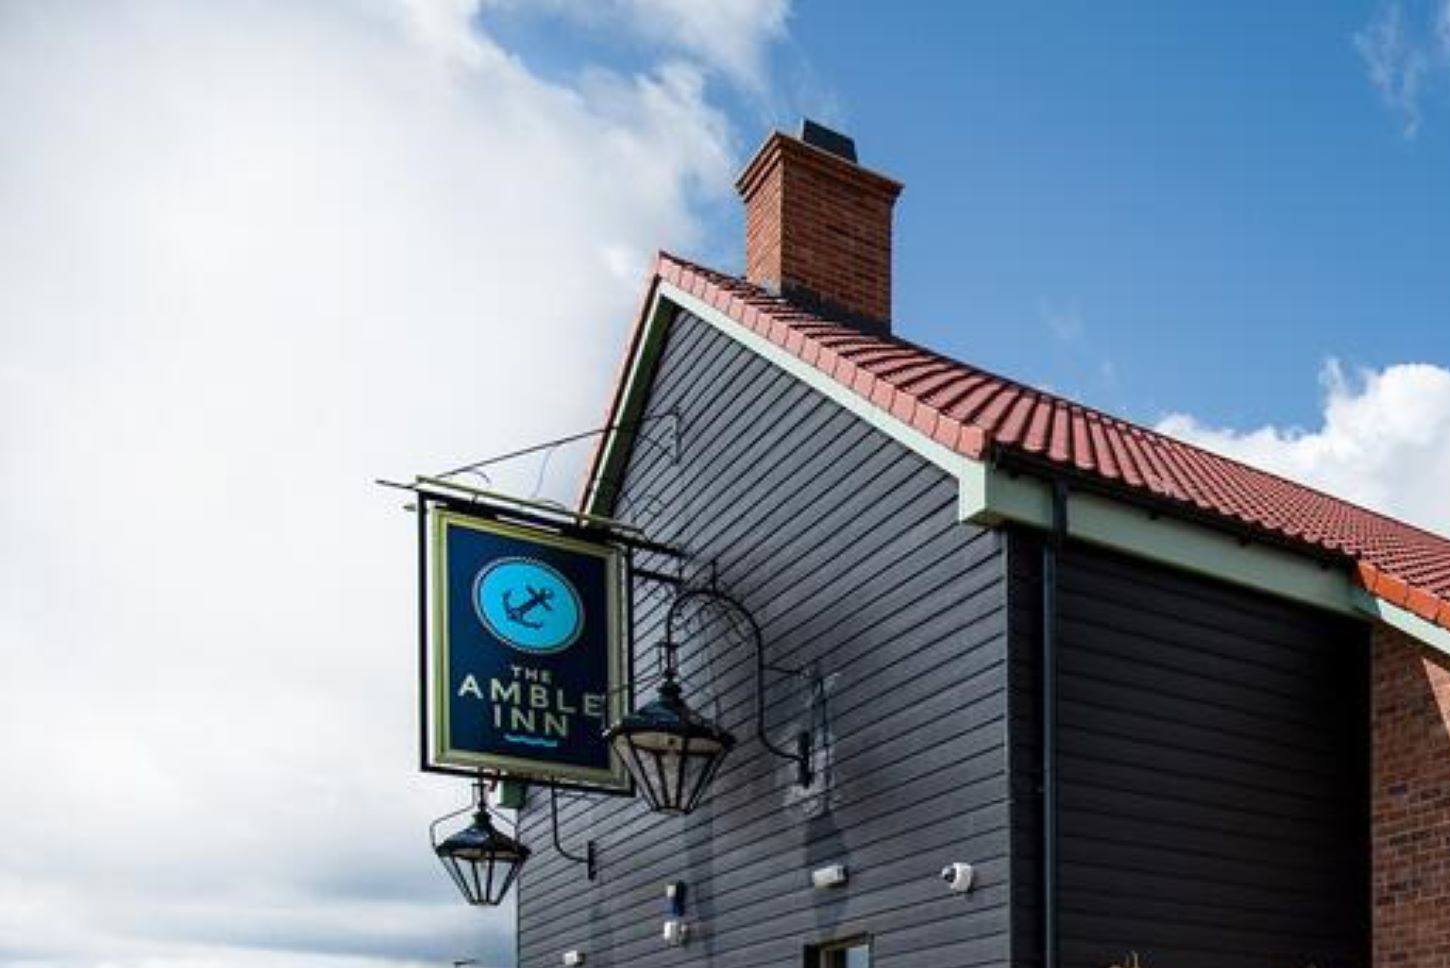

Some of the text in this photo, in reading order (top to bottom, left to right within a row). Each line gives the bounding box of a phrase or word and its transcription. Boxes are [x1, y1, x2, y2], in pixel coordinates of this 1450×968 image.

[511, 664, 552, 683] THE
[457, 672, 606, 717] AMBLE
[493, 703, 569, 737] INN
